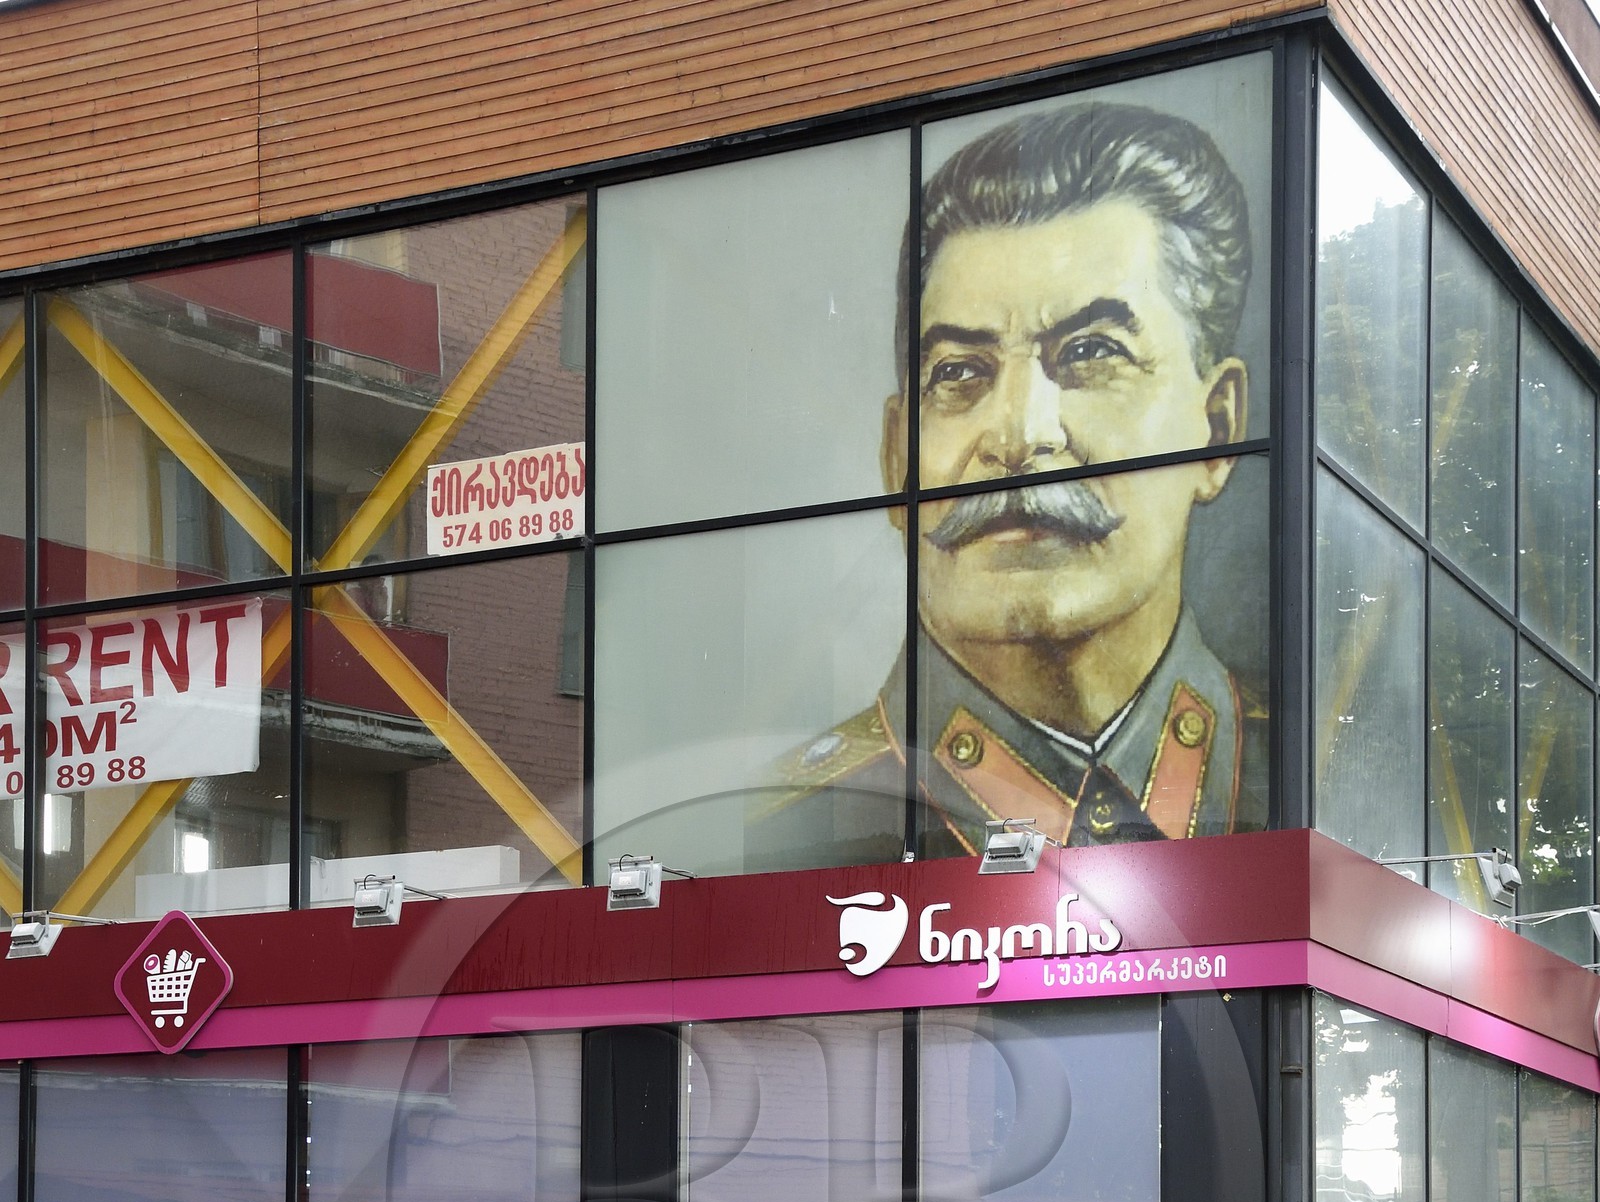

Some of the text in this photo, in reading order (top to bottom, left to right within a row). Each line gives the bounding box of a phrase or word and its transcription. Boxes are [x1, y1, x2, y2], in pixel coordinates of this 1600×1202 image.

[432, 448, 585, 517] ქირავდება
[443, 508, 573, 547] 574 06 89 88
[47, 604, 246, 707] RENT
[57, 762, 95, 789] 89
[107, 756, 146, 782] 88
[919, 893, 1121, 988] ნიკორა
[1043, 955, 1227, 986] სუპერმარკეტი
